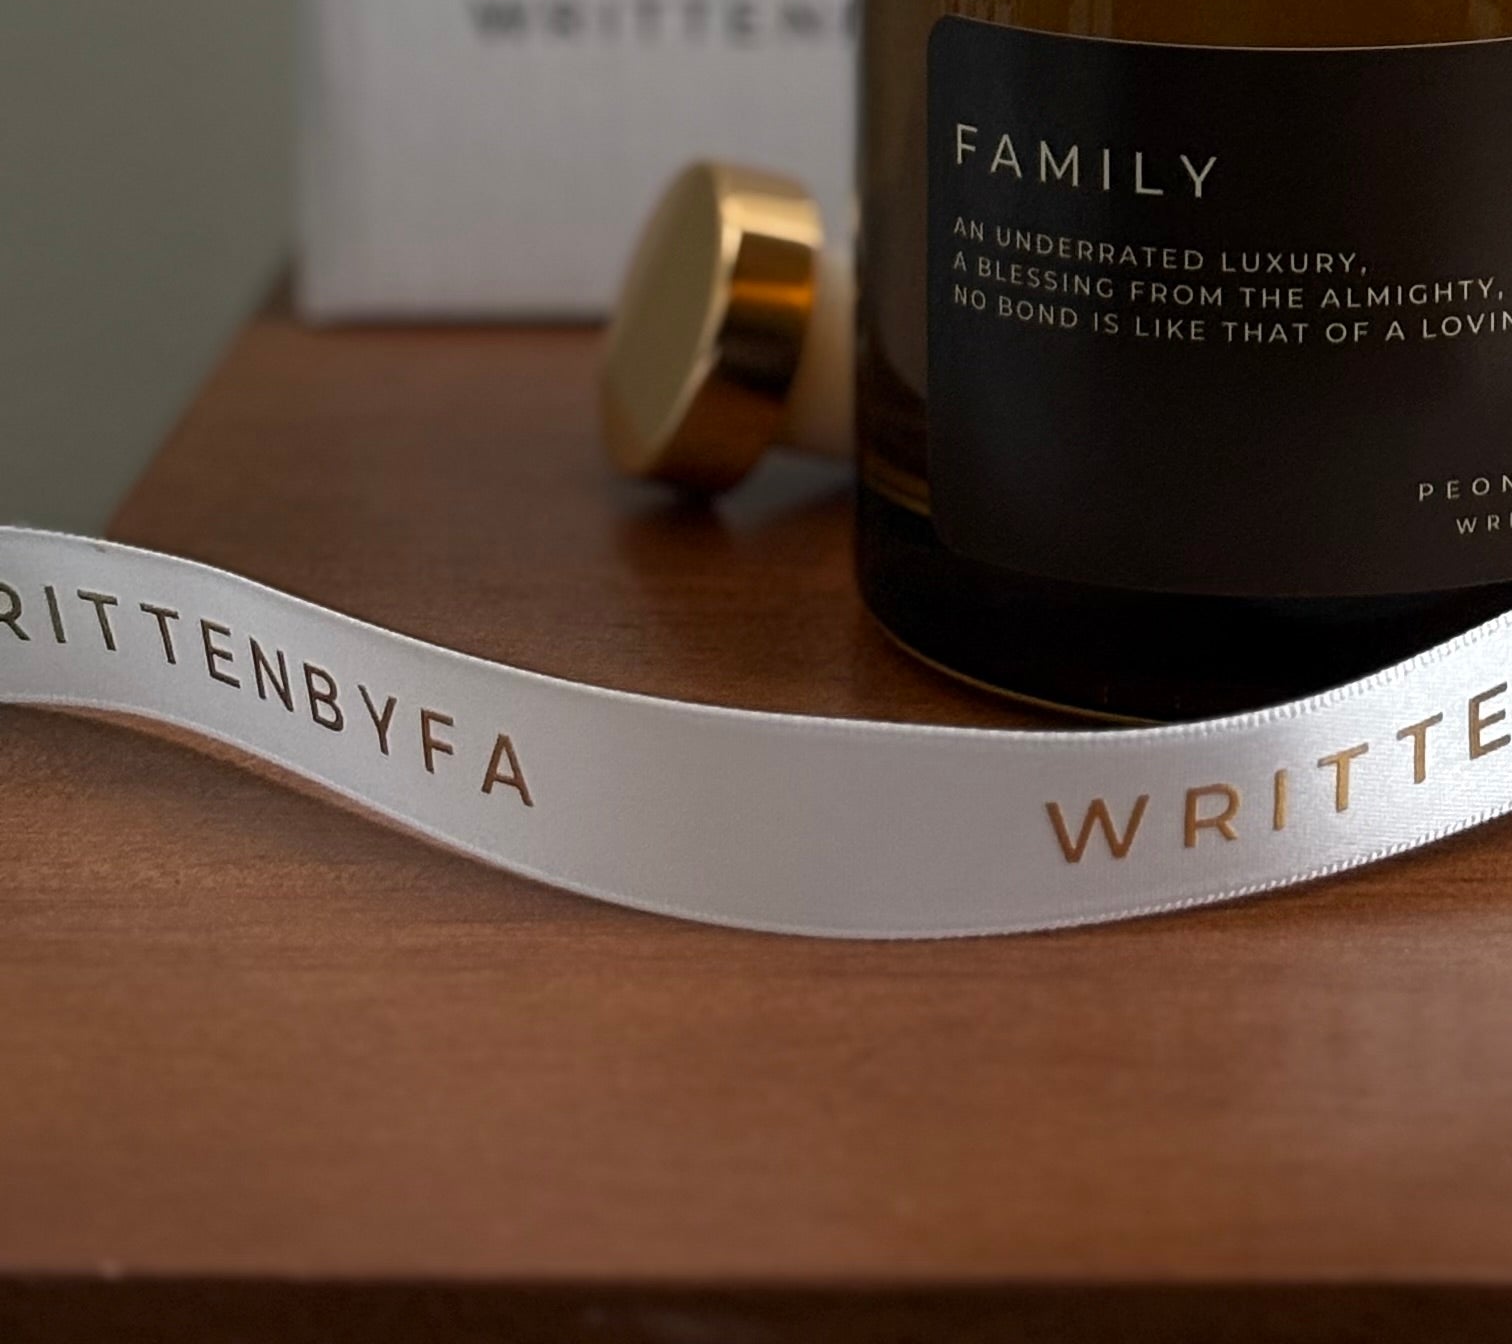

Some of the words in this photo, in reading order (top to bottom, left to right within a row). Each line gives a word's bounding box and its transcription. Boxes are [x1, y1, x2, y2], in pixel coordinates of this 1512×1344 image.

[956, 123, 1217, 198] FAMILY
[953, 216, 985, 241] AN
[996, 225, 1205, 271] UNDERRATED
[1221, 251, 1368, 275] LUXURY,
[953, 250, 968, 272] A
[978, 256, 1114, 299] BLESSING
[1130, 280, 1223, 308] FROM
[1239, 286, 1304, 309] THE
[1320, 276, 1504, 309] ALMIGHTY,
[954, 284, 987, 311] NO
[999, 295, 1079, 329] BOND
[1093, 311, 1119, 334] IS
[1135, 315, 1206, 341] LIKE
[1221, 321, 1310, 344] THAT
[1325, 321, 1370, 344] OF
[1384, 320, 1406, 342] A
